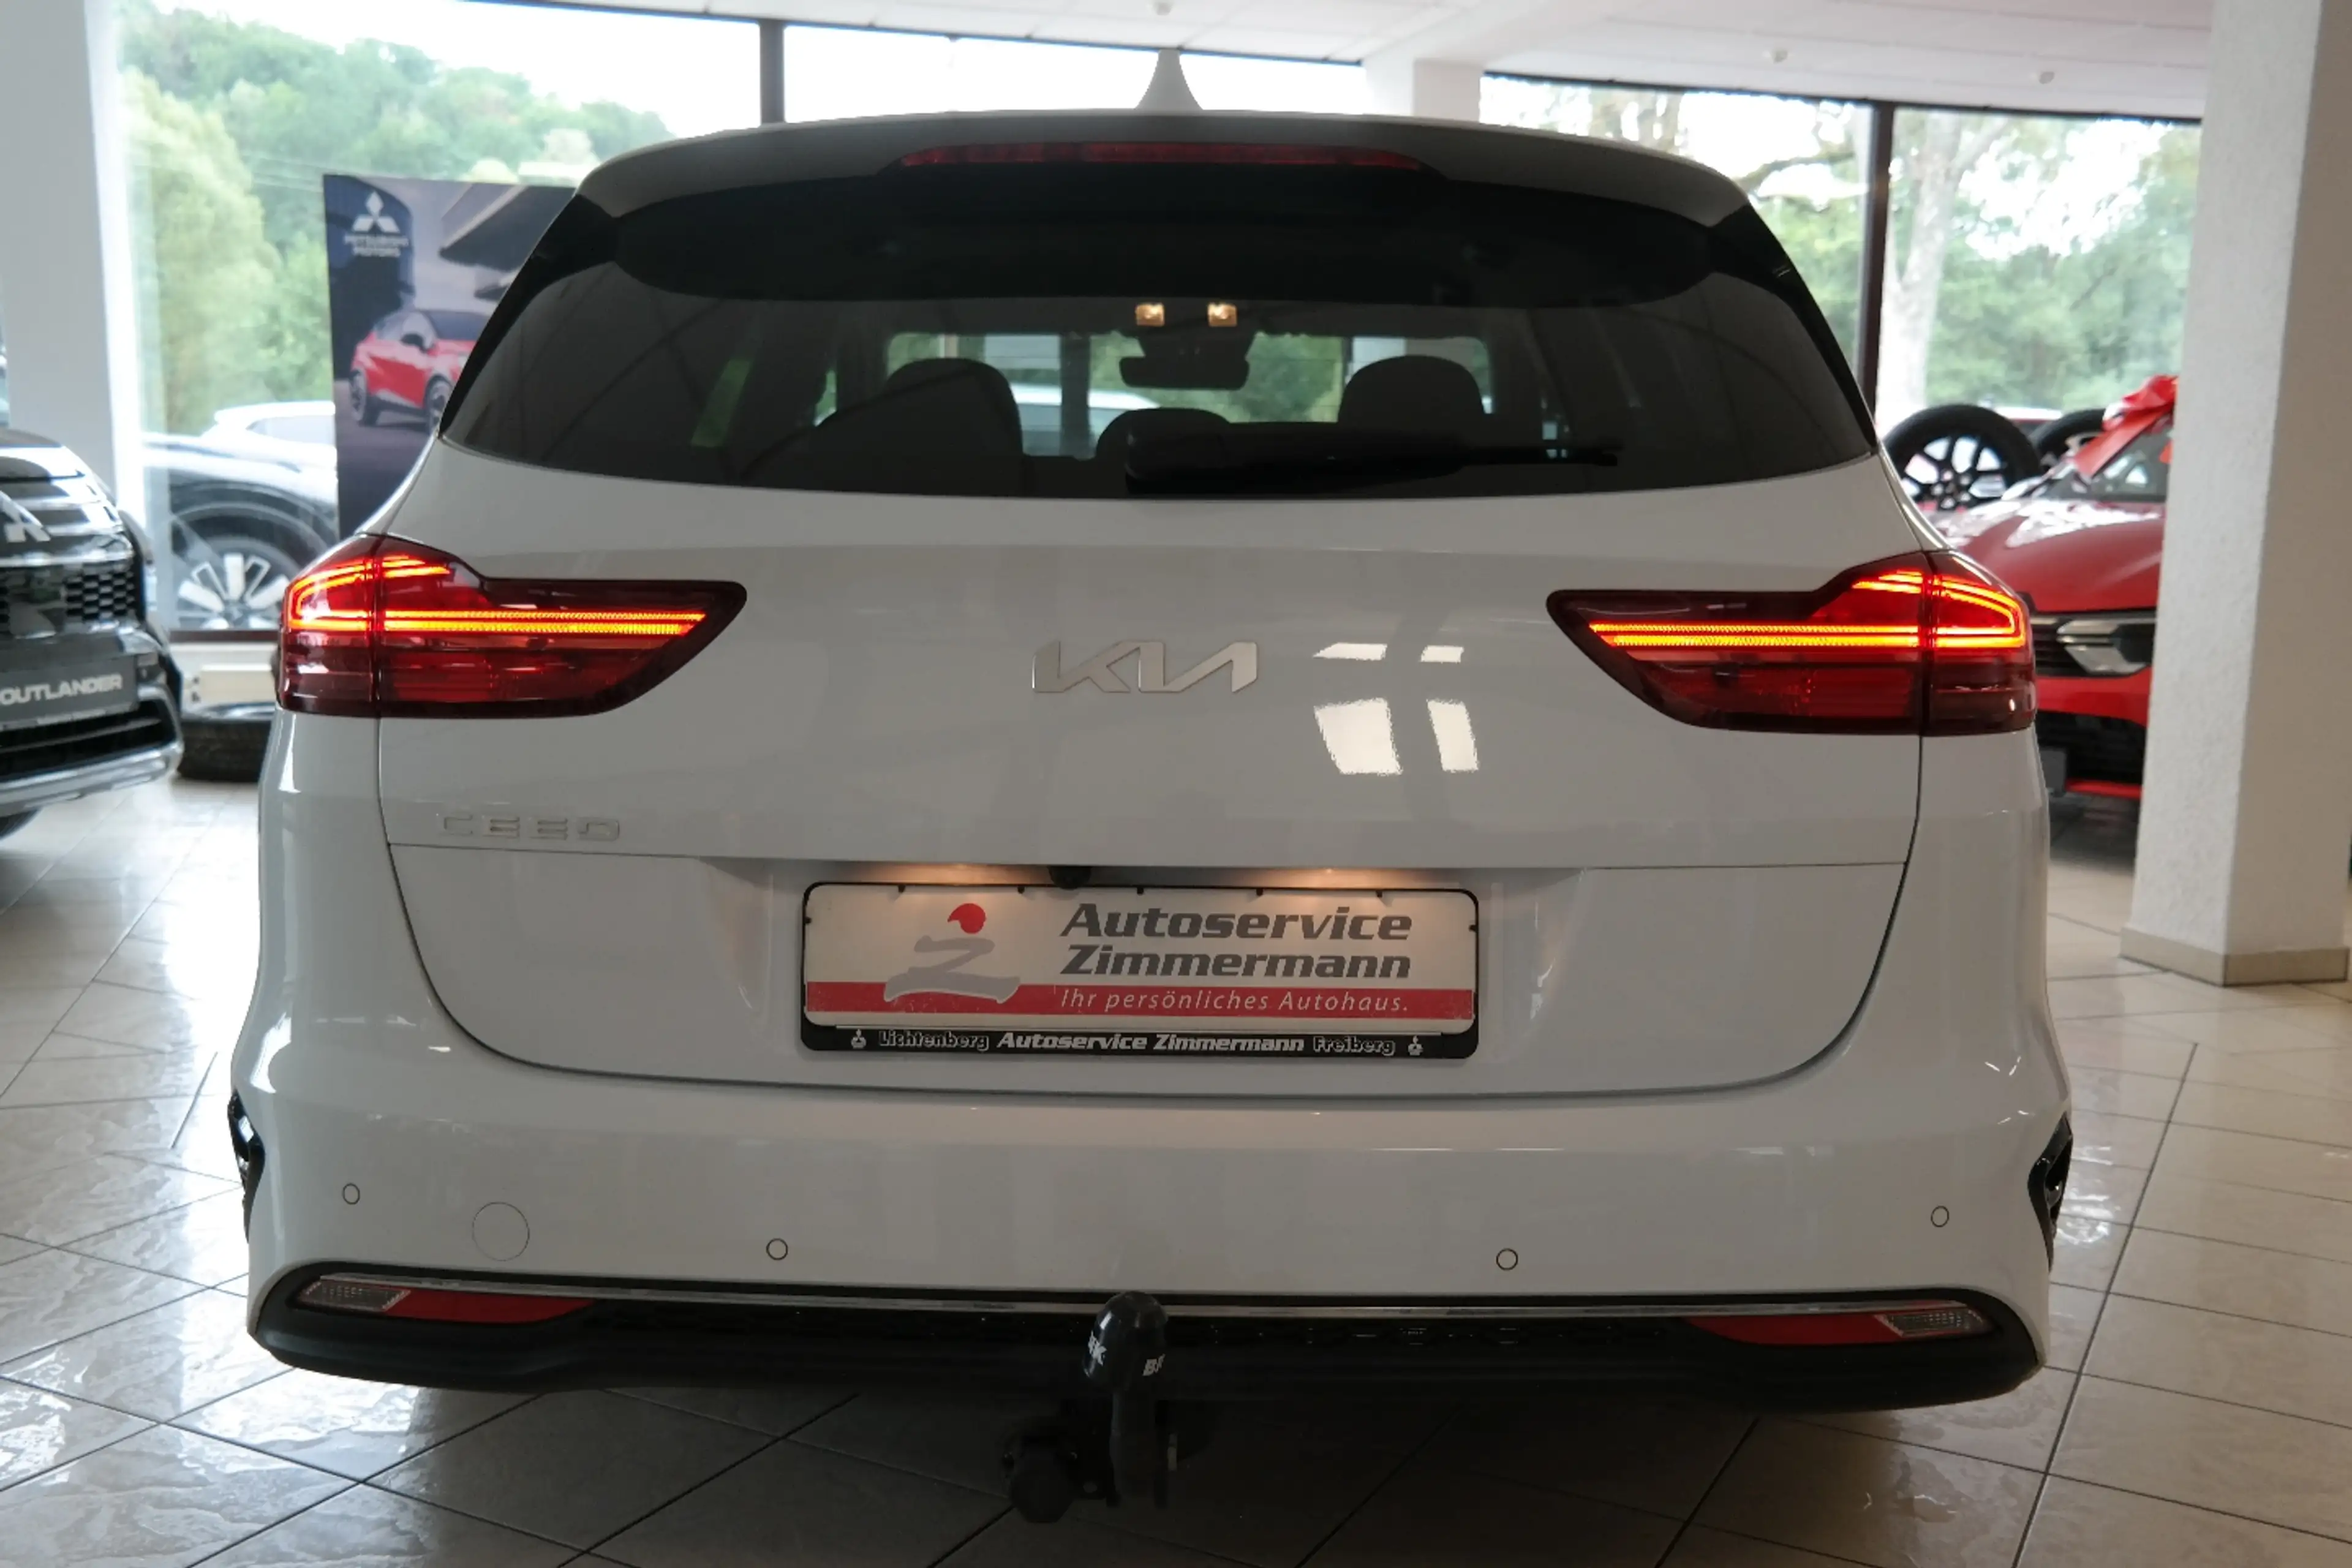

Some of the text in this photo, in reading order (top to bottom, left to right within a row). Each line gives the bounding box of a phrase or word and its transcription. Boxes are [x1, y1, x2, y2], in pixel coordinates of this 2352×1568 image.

[1032, 639, 1258, 693] KIA
[0, 673, 123, 706] OUTLANDER
[442, 813, 621, 842] CEED
[1060, 903, 1412, 940] Autoservice
[1060, 944, 1411, 978] Zimmermann
[1061, 989, 1408, 1012] Ihr persönliches Autohaus.
[878, 1030, 1396, 1056] Lichtenberg Autoservice Zimmermann Freiberg
